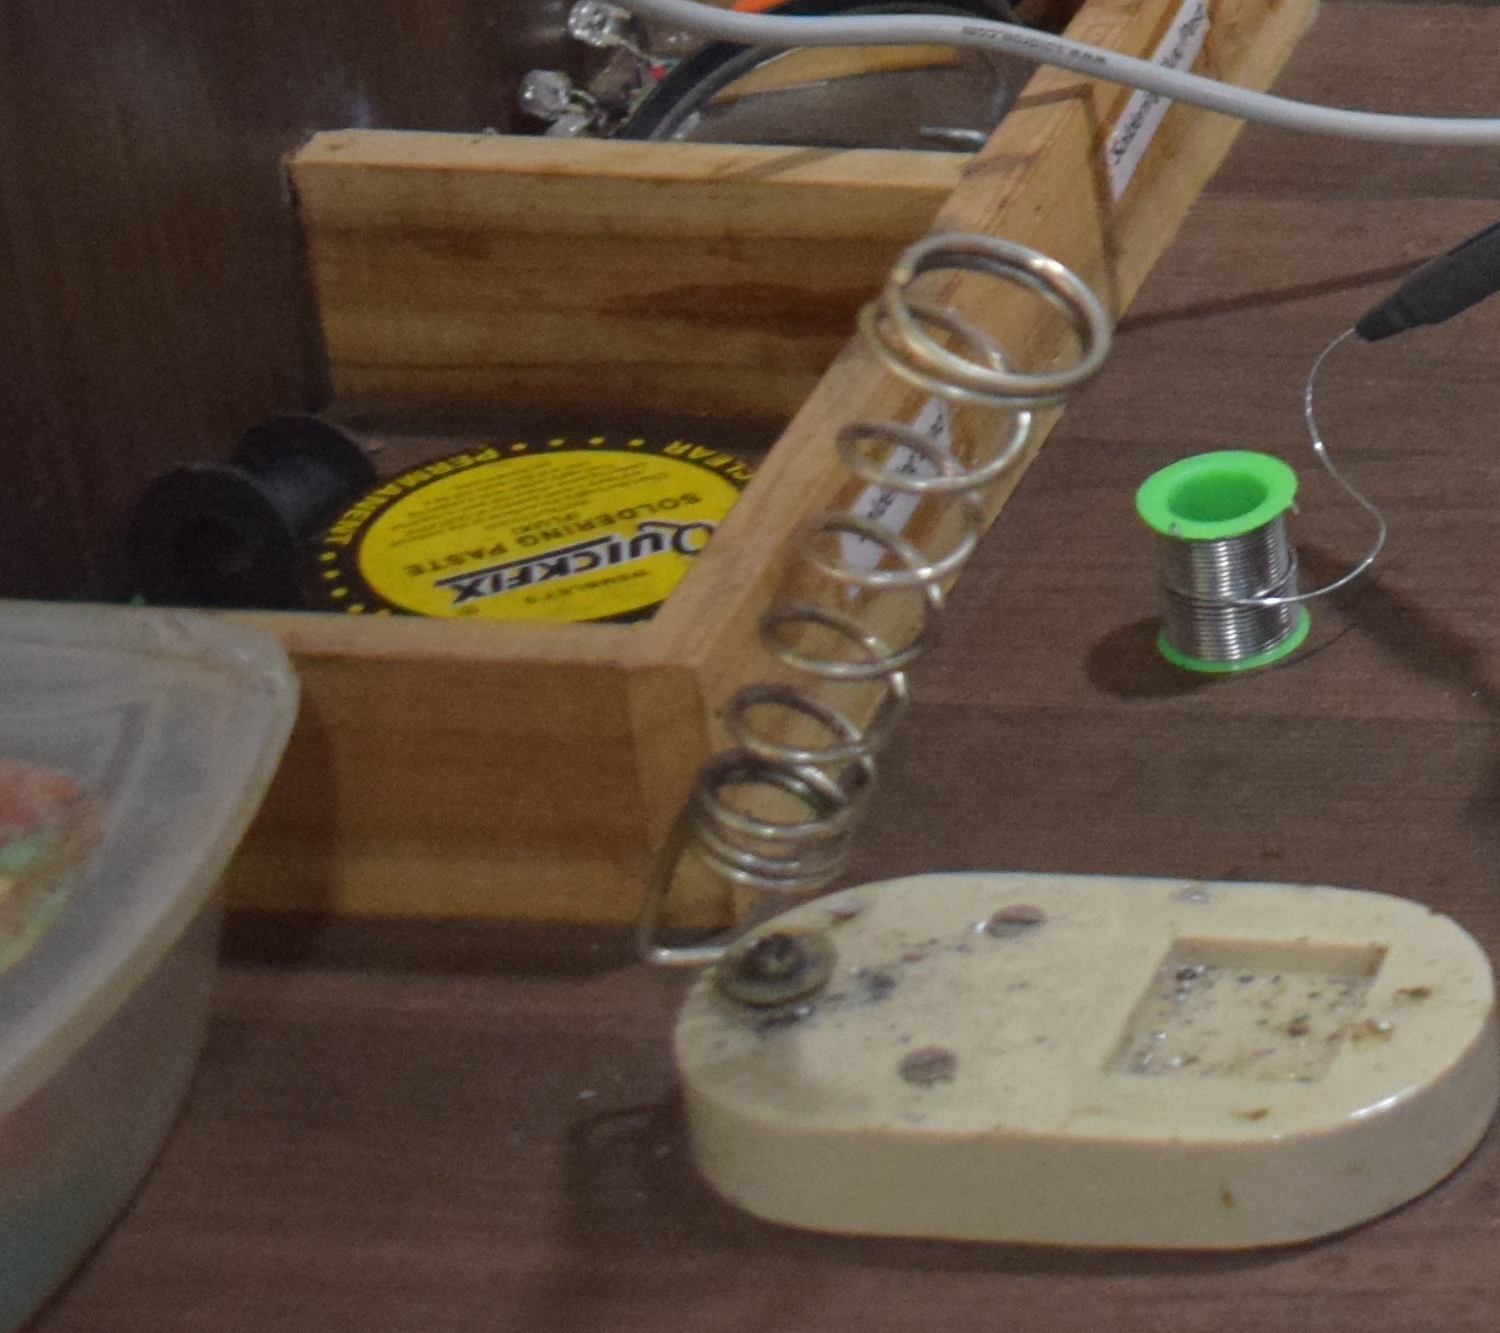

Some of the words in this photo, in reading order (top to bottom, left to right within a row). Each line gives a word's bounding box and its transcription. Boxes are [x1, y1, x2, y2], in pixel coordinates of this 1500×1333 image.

[323, 445, 500, 545] PERMANENT
[515, 492, 701, 548] SOLDERING
[404, 543, 509, 576] PASTE
[452, 520, 716, 604] QUICKFIX
